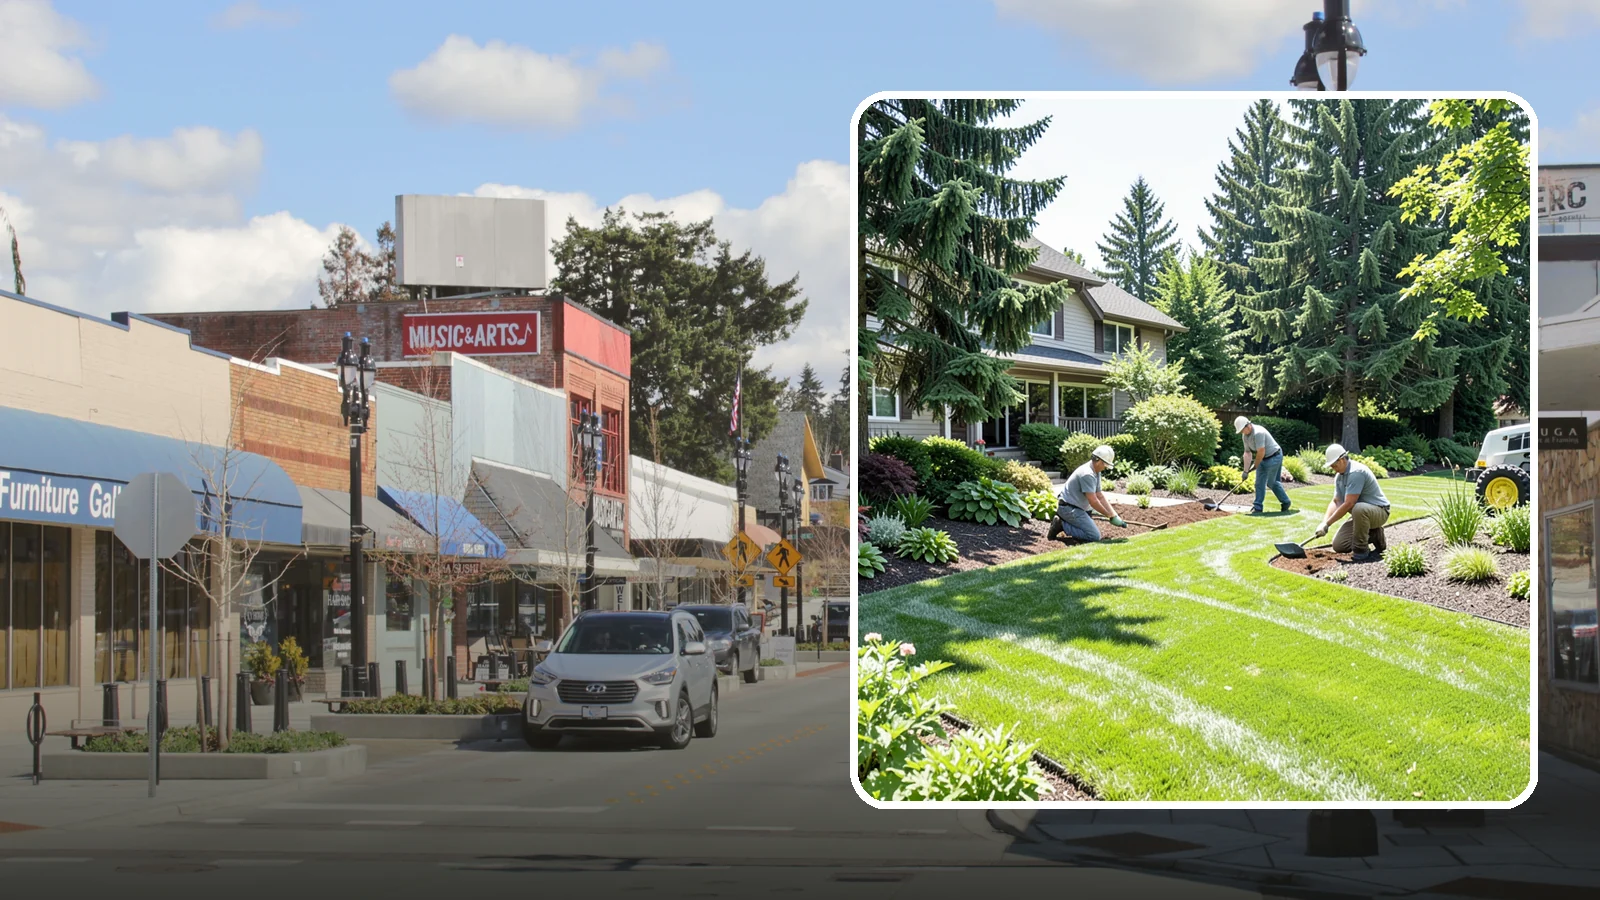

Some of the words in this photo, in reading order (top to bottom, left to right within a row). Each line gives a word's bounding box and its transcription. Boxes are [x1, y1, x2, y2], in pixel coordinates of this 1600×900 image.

[1540, 427, 1577, 436] UGA
[0, 471, 79, 515] Furniture
[89, 482, 122, 519] Gal
